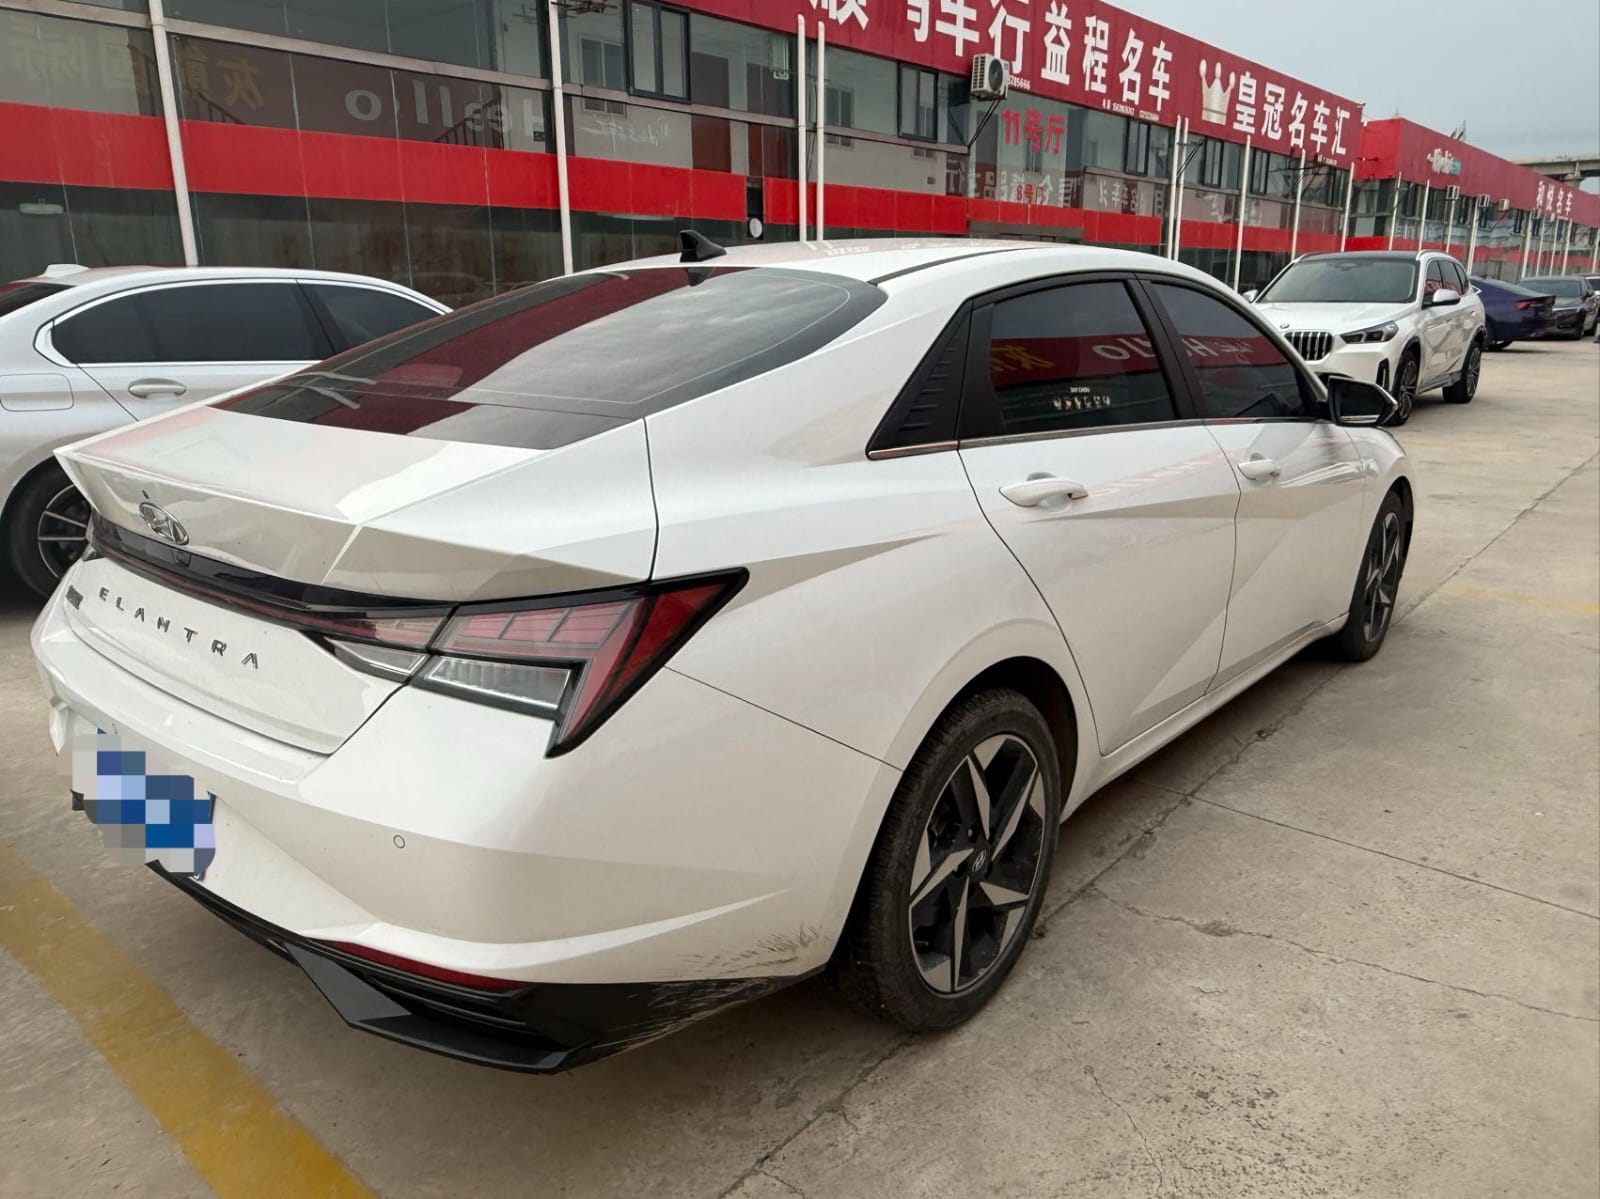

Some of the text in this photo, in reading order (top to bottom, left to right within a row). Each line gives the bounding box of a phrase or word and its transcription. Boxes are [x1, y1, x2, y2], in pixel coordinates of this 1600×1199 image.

[1041, 7, 1173, 112] 益程名车
[1002, 107, 1066, 155] 11号厅
[1232, 70, 1350, 155] 皇冠名车汇
[98, 587, 259, 669] ELANTRA
